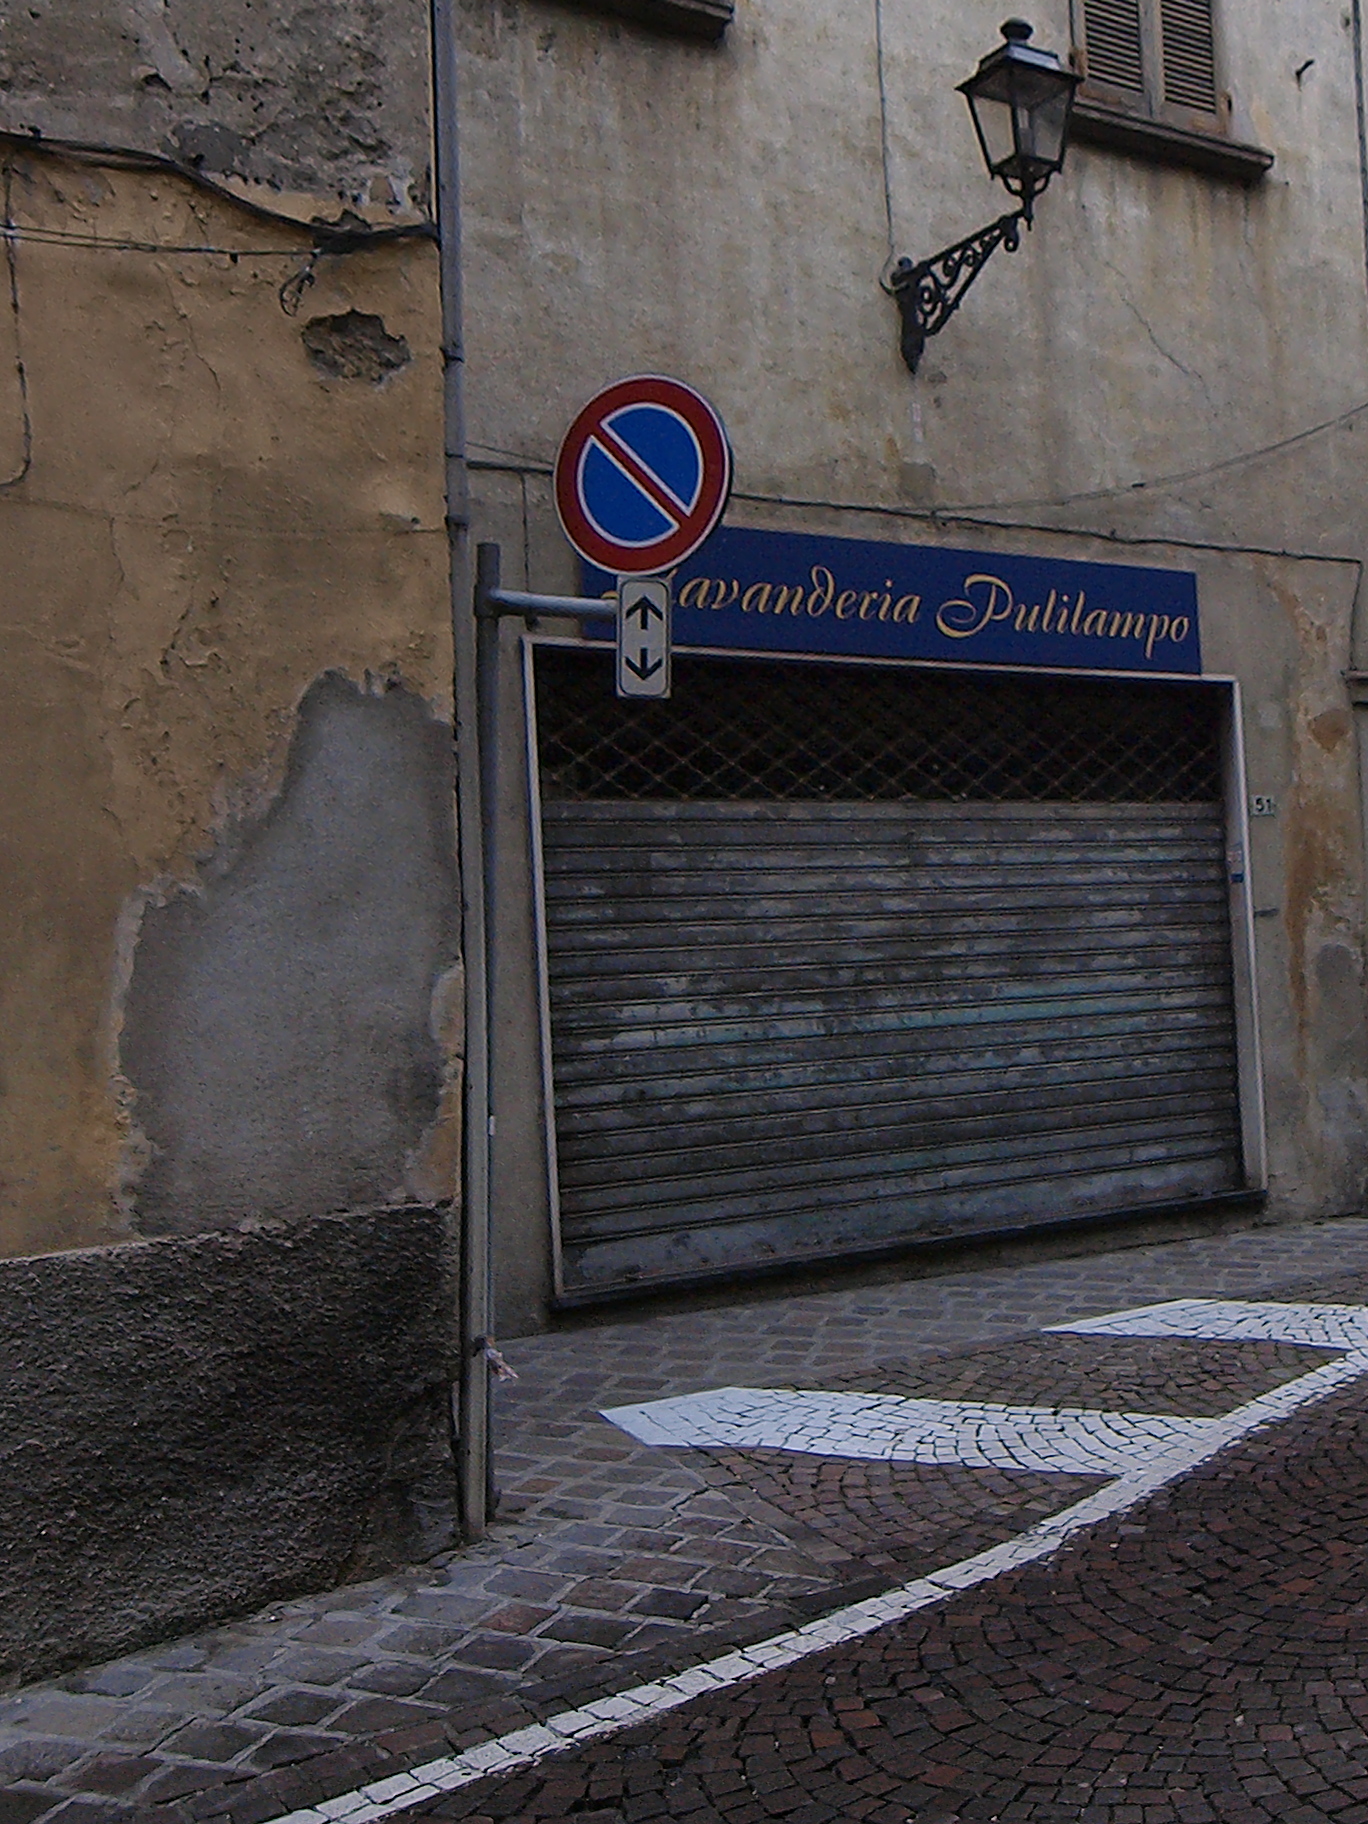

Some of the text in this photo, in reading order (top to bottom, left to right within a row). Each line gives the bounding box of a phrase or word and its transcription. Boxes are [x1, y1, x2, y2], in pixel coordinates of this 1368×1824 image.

[601, 565, 1190, 660] avanderia Pulilampo
[1254, 797, 1272, 812] 51
